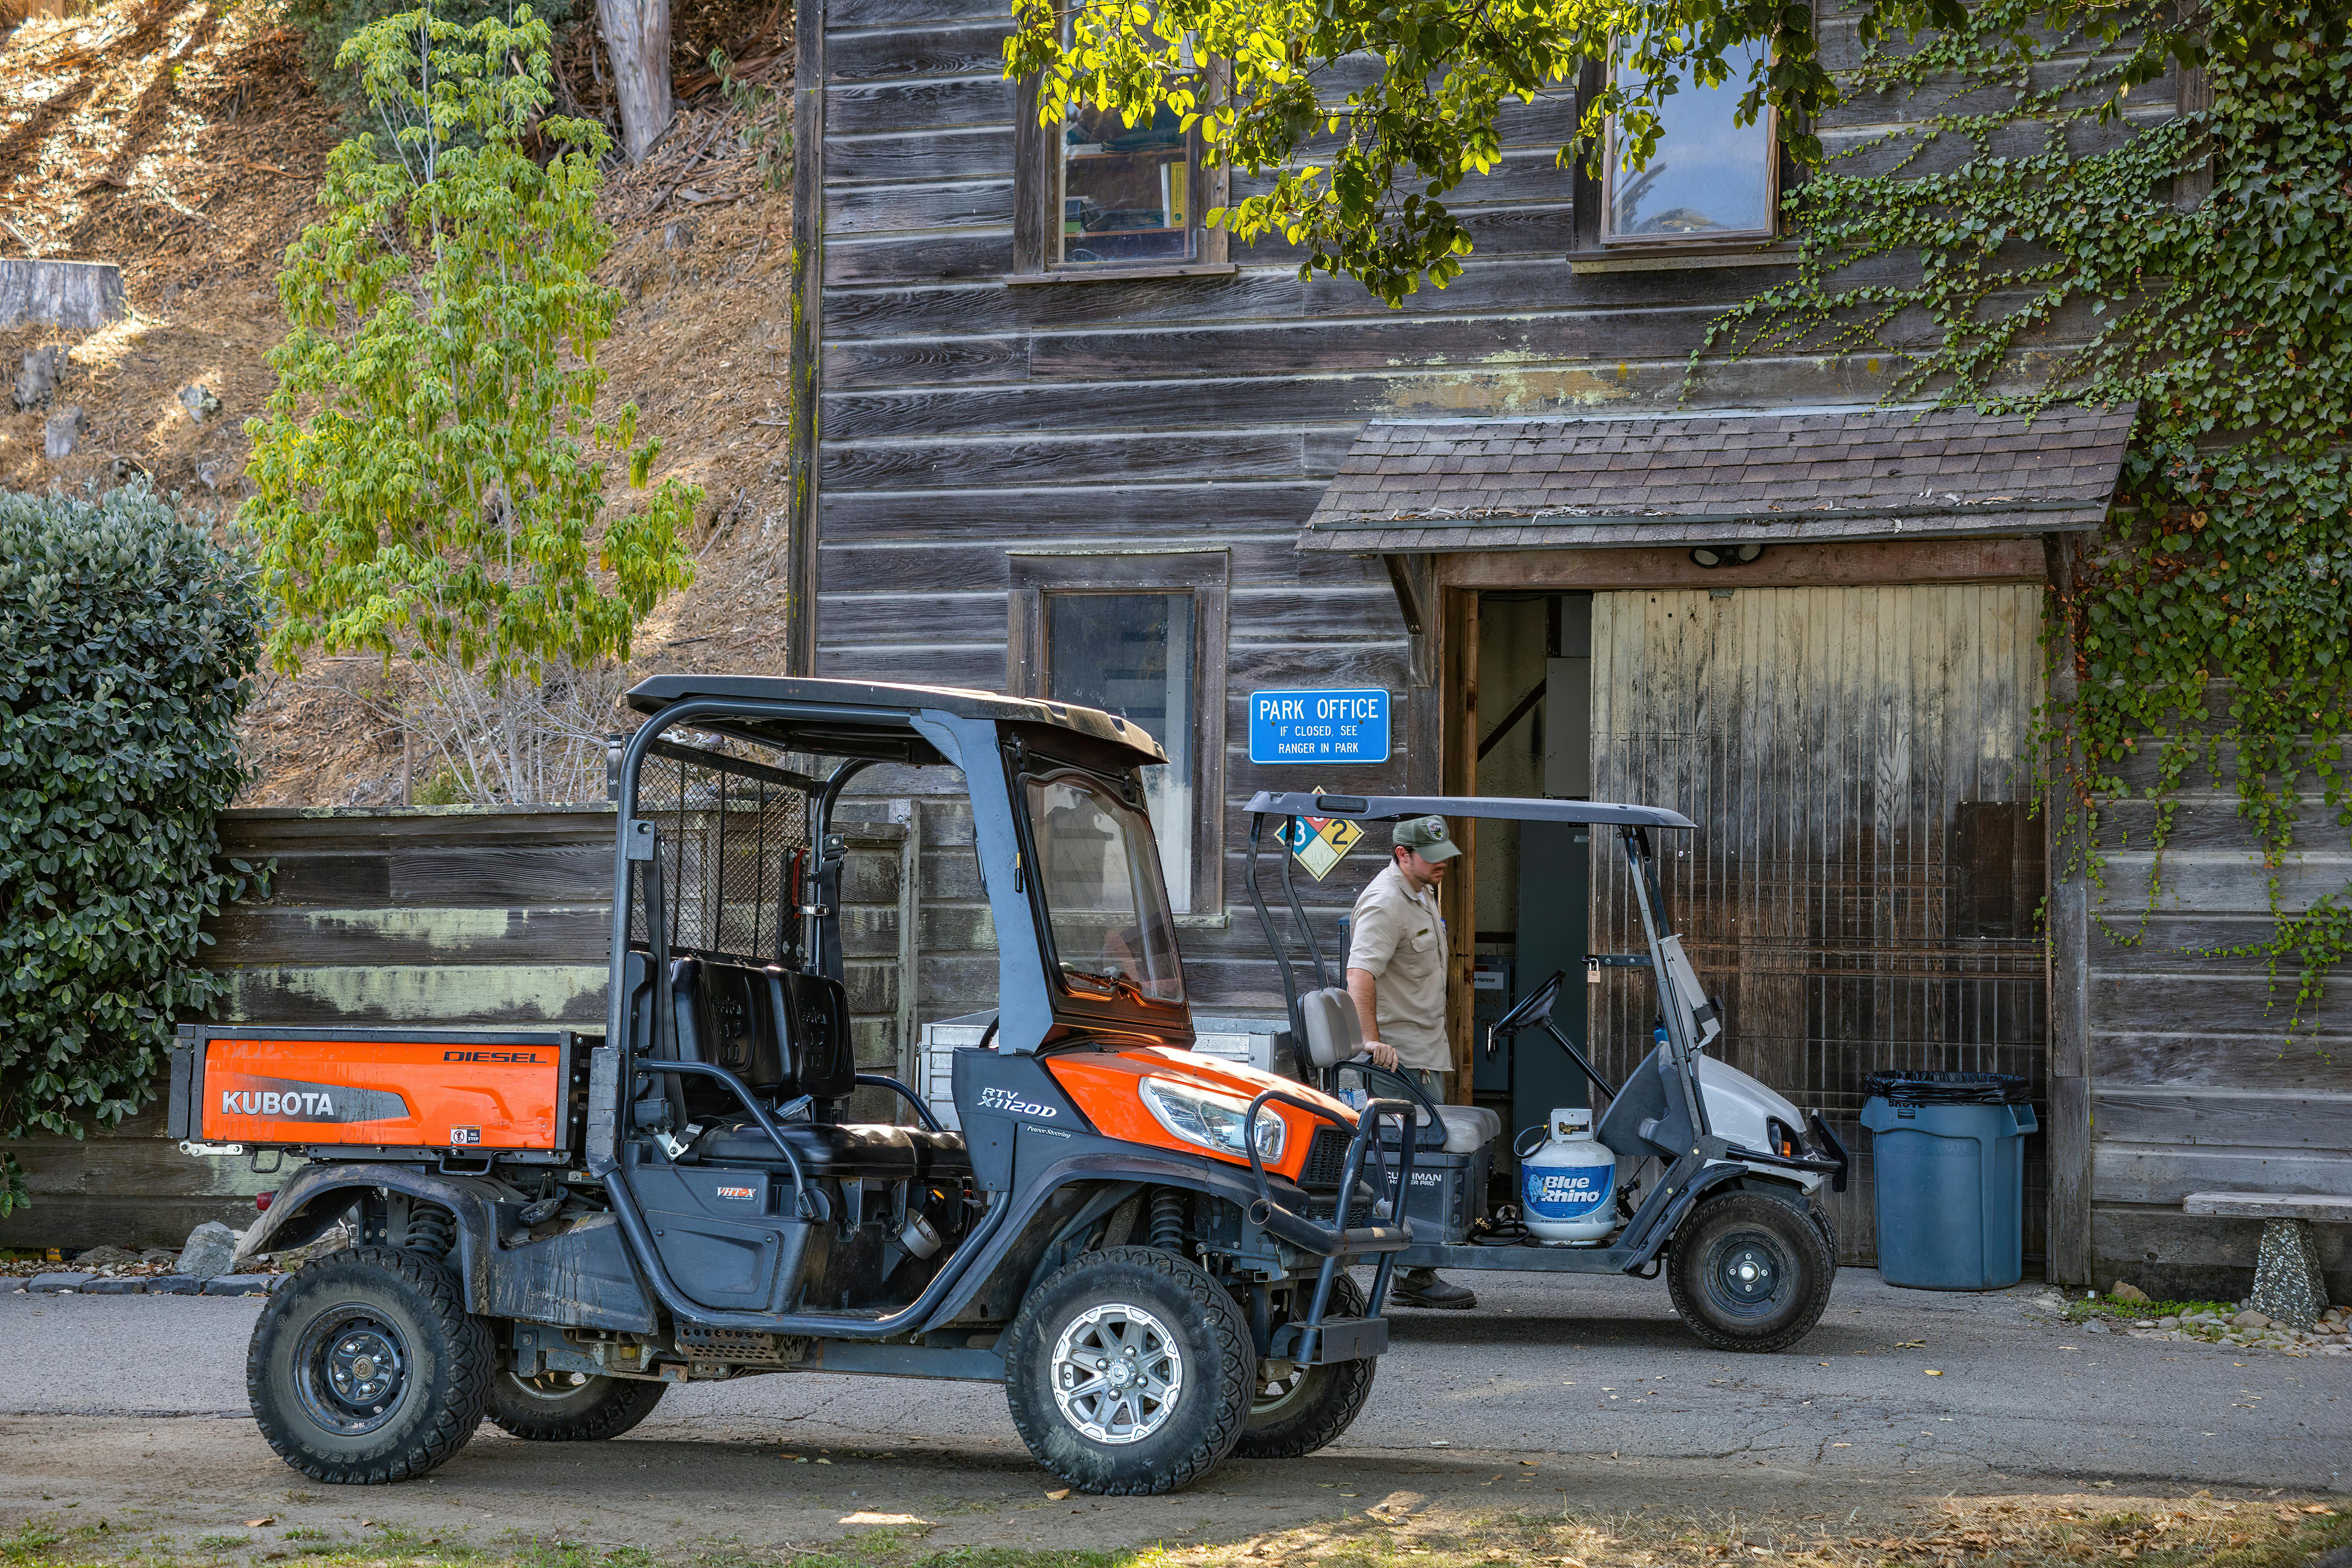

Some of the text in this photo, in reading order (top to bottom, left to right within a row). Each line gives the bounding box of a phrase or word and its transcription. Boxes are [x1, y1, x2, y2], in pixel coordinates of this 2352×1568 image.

[1260, 699, 1378, 720] PARK OFFICE
[1280, 725, 1357, 737] IF CLOSED, SEE
[1279, 743, 1358, 753] RANGER IN PARK
[1294, 821, 1306, 846] 3
[1331, 820, 1348, 845] 2
[443, 1052, 547, 1063] DIESEL
[982, 1087, 1018, 1099] RTV
[222, 1091, 334, 1116] KUBOTA
[977, 1095, 1057, 1117] X1120D
[1387, 1171, 1441, 1182] UMAN
[1545, 1176, 1590, 1188] Blue
[717, 1187, 757, 1197] VHT-X
[1541, 1189, 1599, 1202] Rhino
